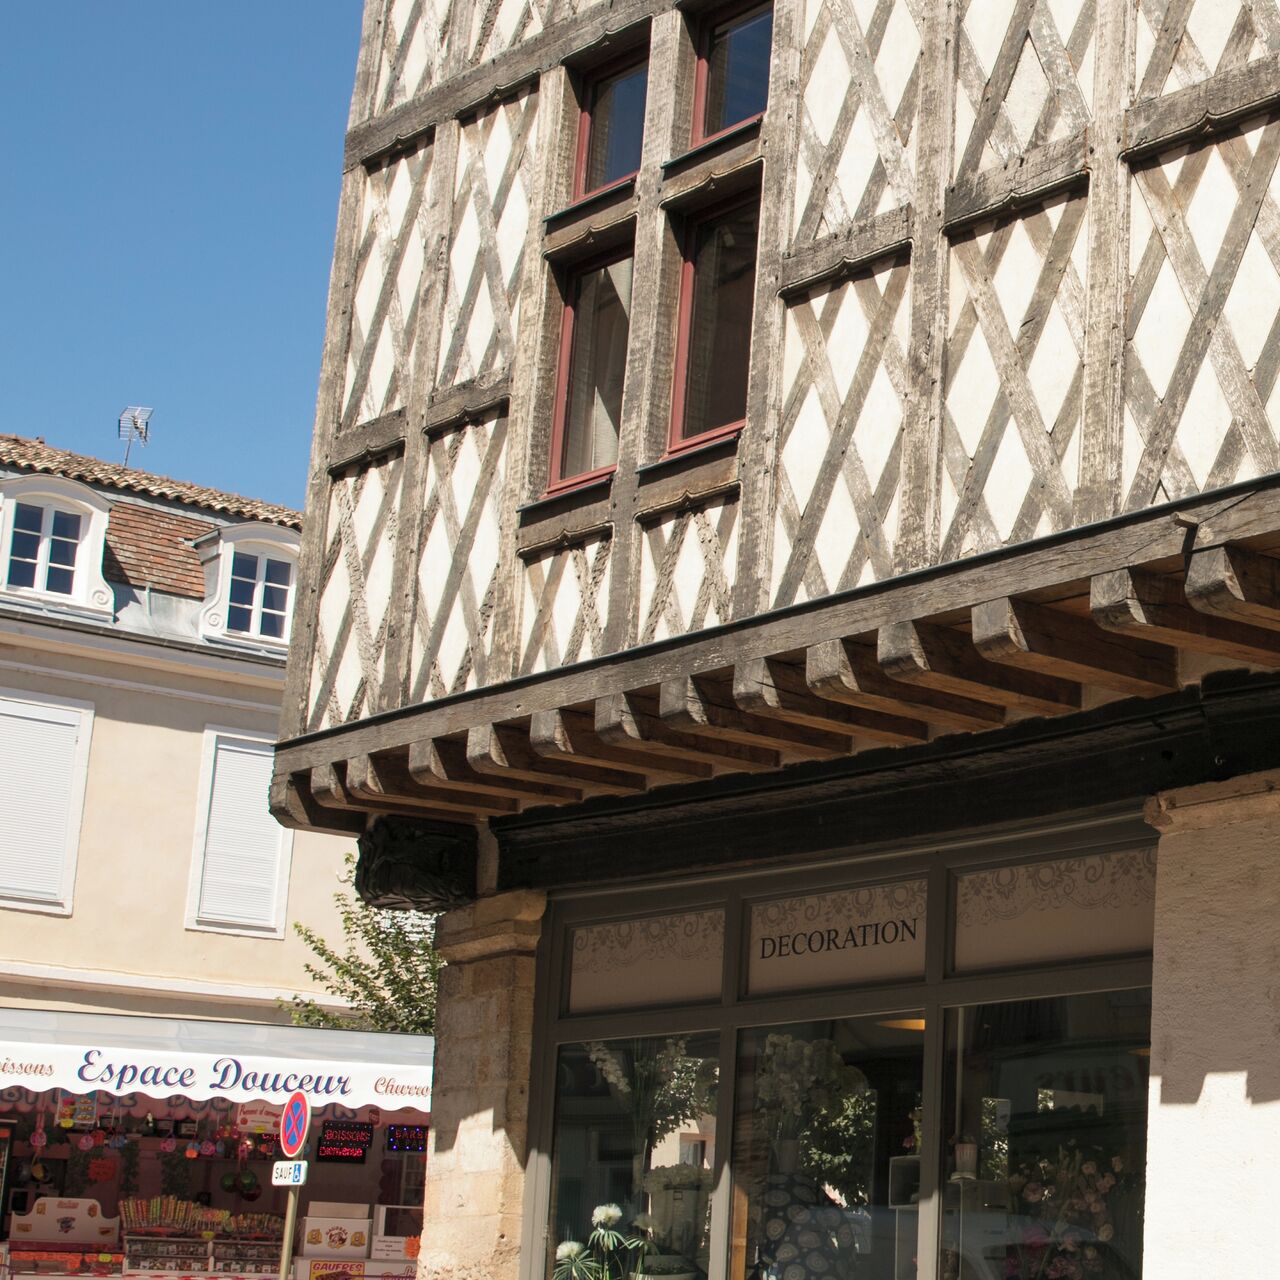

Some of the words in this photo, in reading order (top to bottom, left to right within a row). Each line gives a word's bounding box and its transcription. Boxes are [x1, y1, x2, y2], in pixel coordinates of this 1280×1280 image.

[760, 918, 918, 960] DECORATION
[0, 1057, 56, 1077] issons
[77, 1049, 196, 1090] Espace
[209, 1057, 353, 1096] Douceur
[275, 1167, 292, 1180] SAUF
[313, 1262, 363, 1273] GAUFRES
